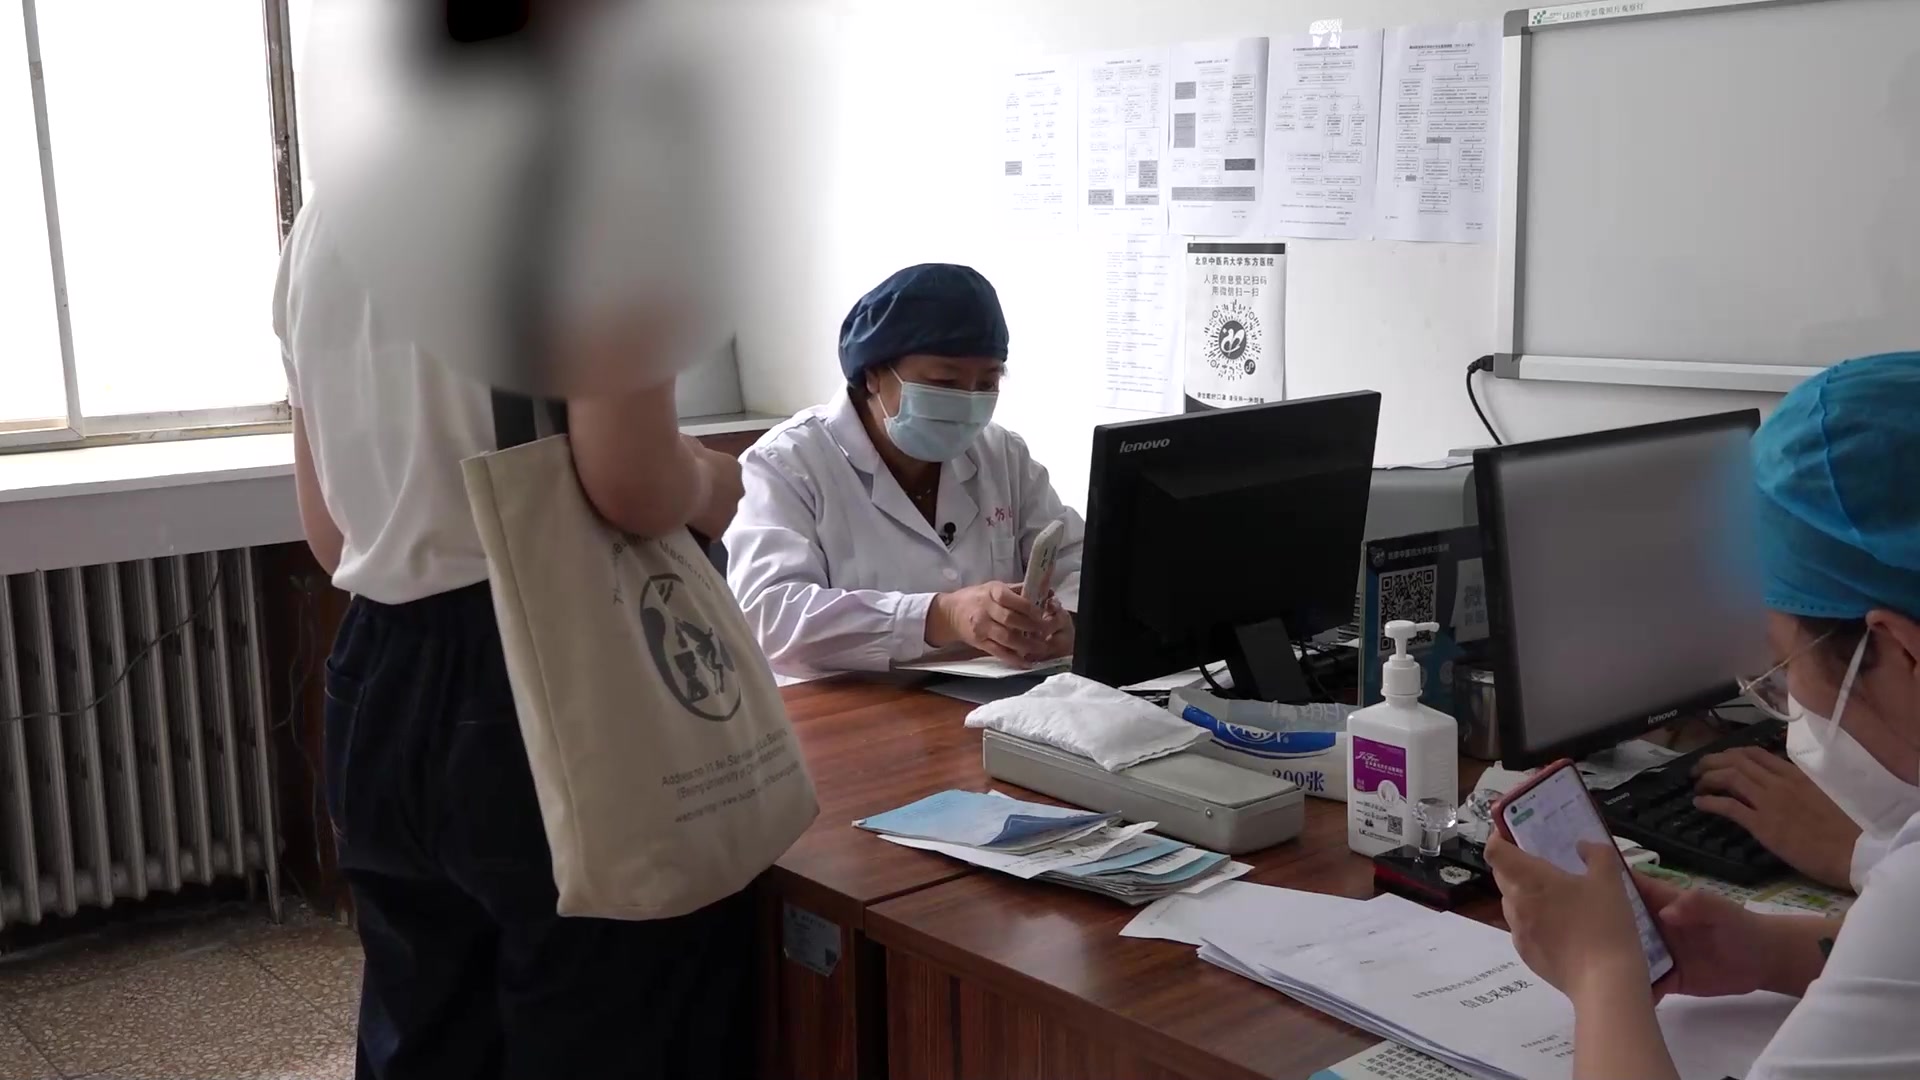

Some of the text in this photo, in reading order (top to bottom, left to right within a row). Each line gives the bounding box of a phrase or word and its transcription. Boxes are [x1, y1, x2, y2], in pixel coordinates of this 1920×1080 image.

[1194, 256, 1275, 267] 北京中医药大学东方医院
[1203, 274, 1268, 285] 人员信息登记扫码
[1211, 286, 1260, 297] 用微信扫一扫
[1119, 437, 1171, 454] lenovo
[1647, 709, 1678, 725] lenovo
